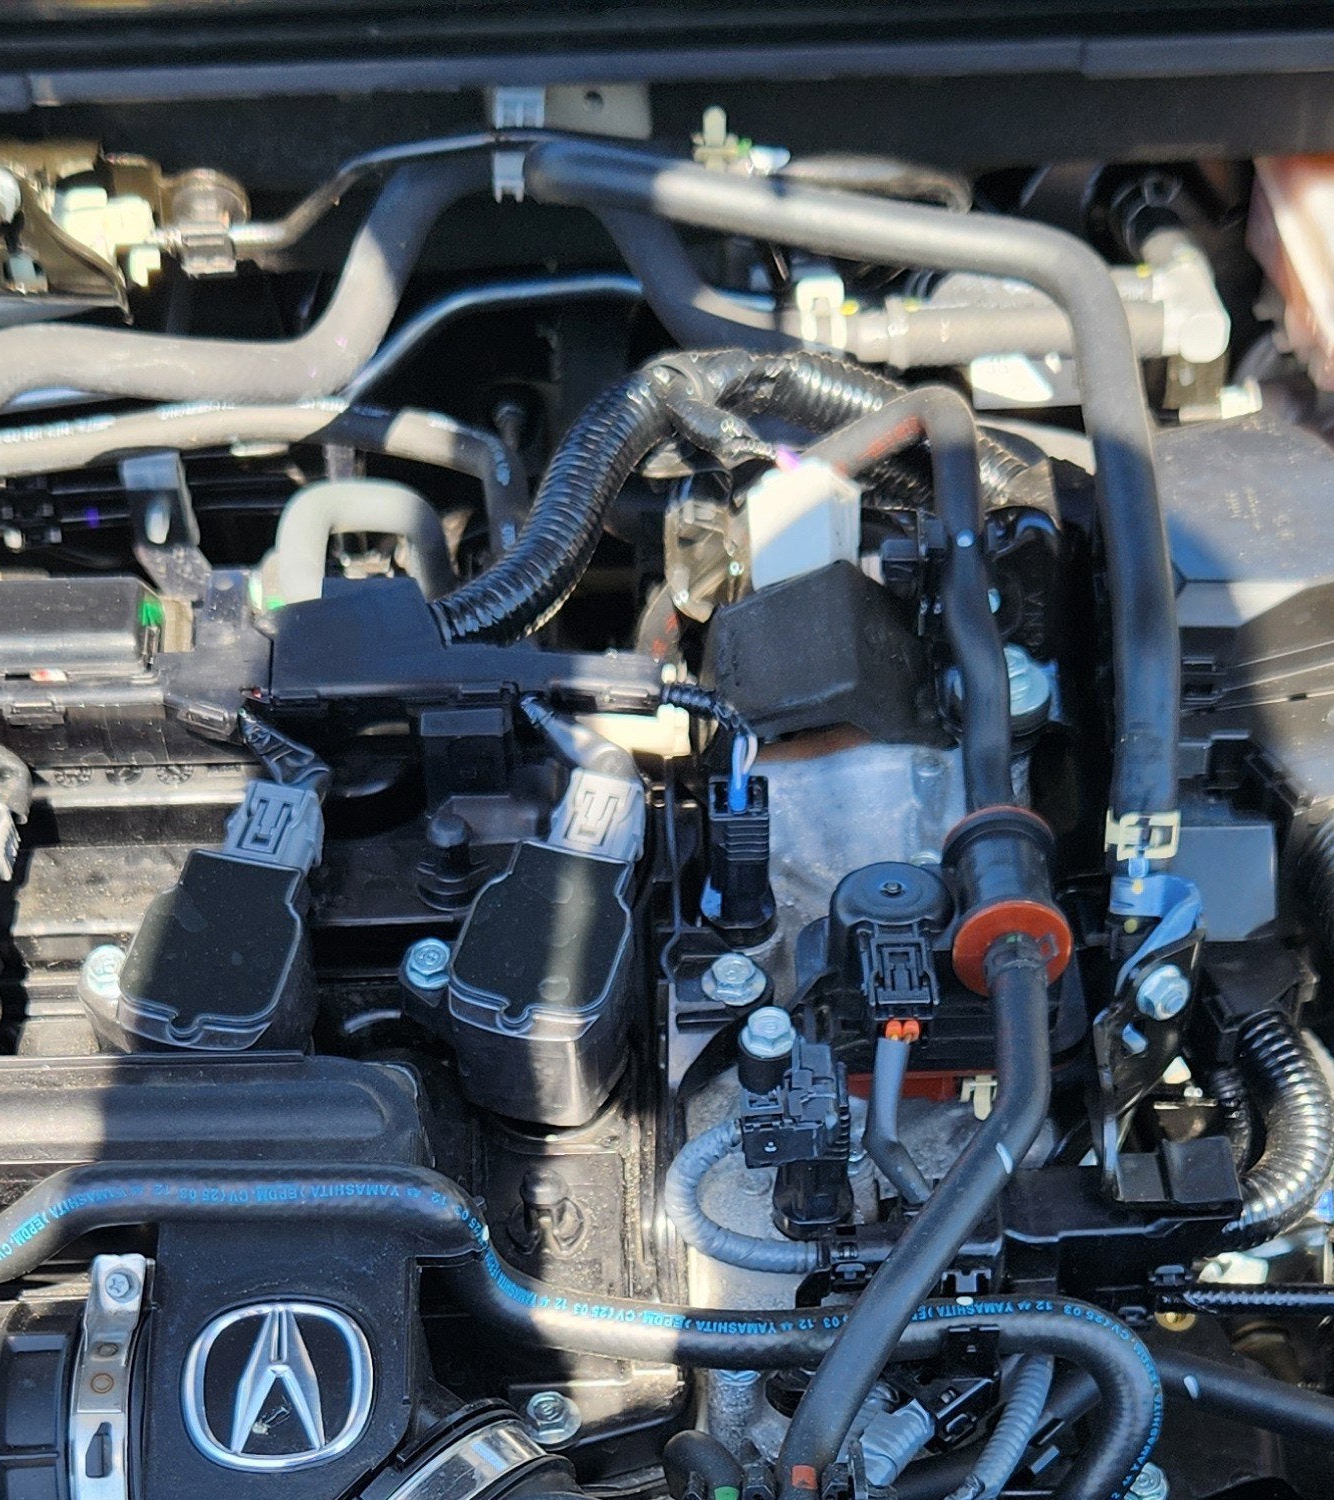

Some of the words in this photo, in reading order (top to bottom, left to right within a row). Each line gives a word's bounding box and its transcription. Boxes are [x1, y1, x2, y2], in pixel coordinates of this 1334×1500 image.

[310, 1184, 399, 1198] YAMASHITA
[938, 1301, 1014, 1318] YAMASHITA
[694, 1319, 776, 1334] YAMASHITA
